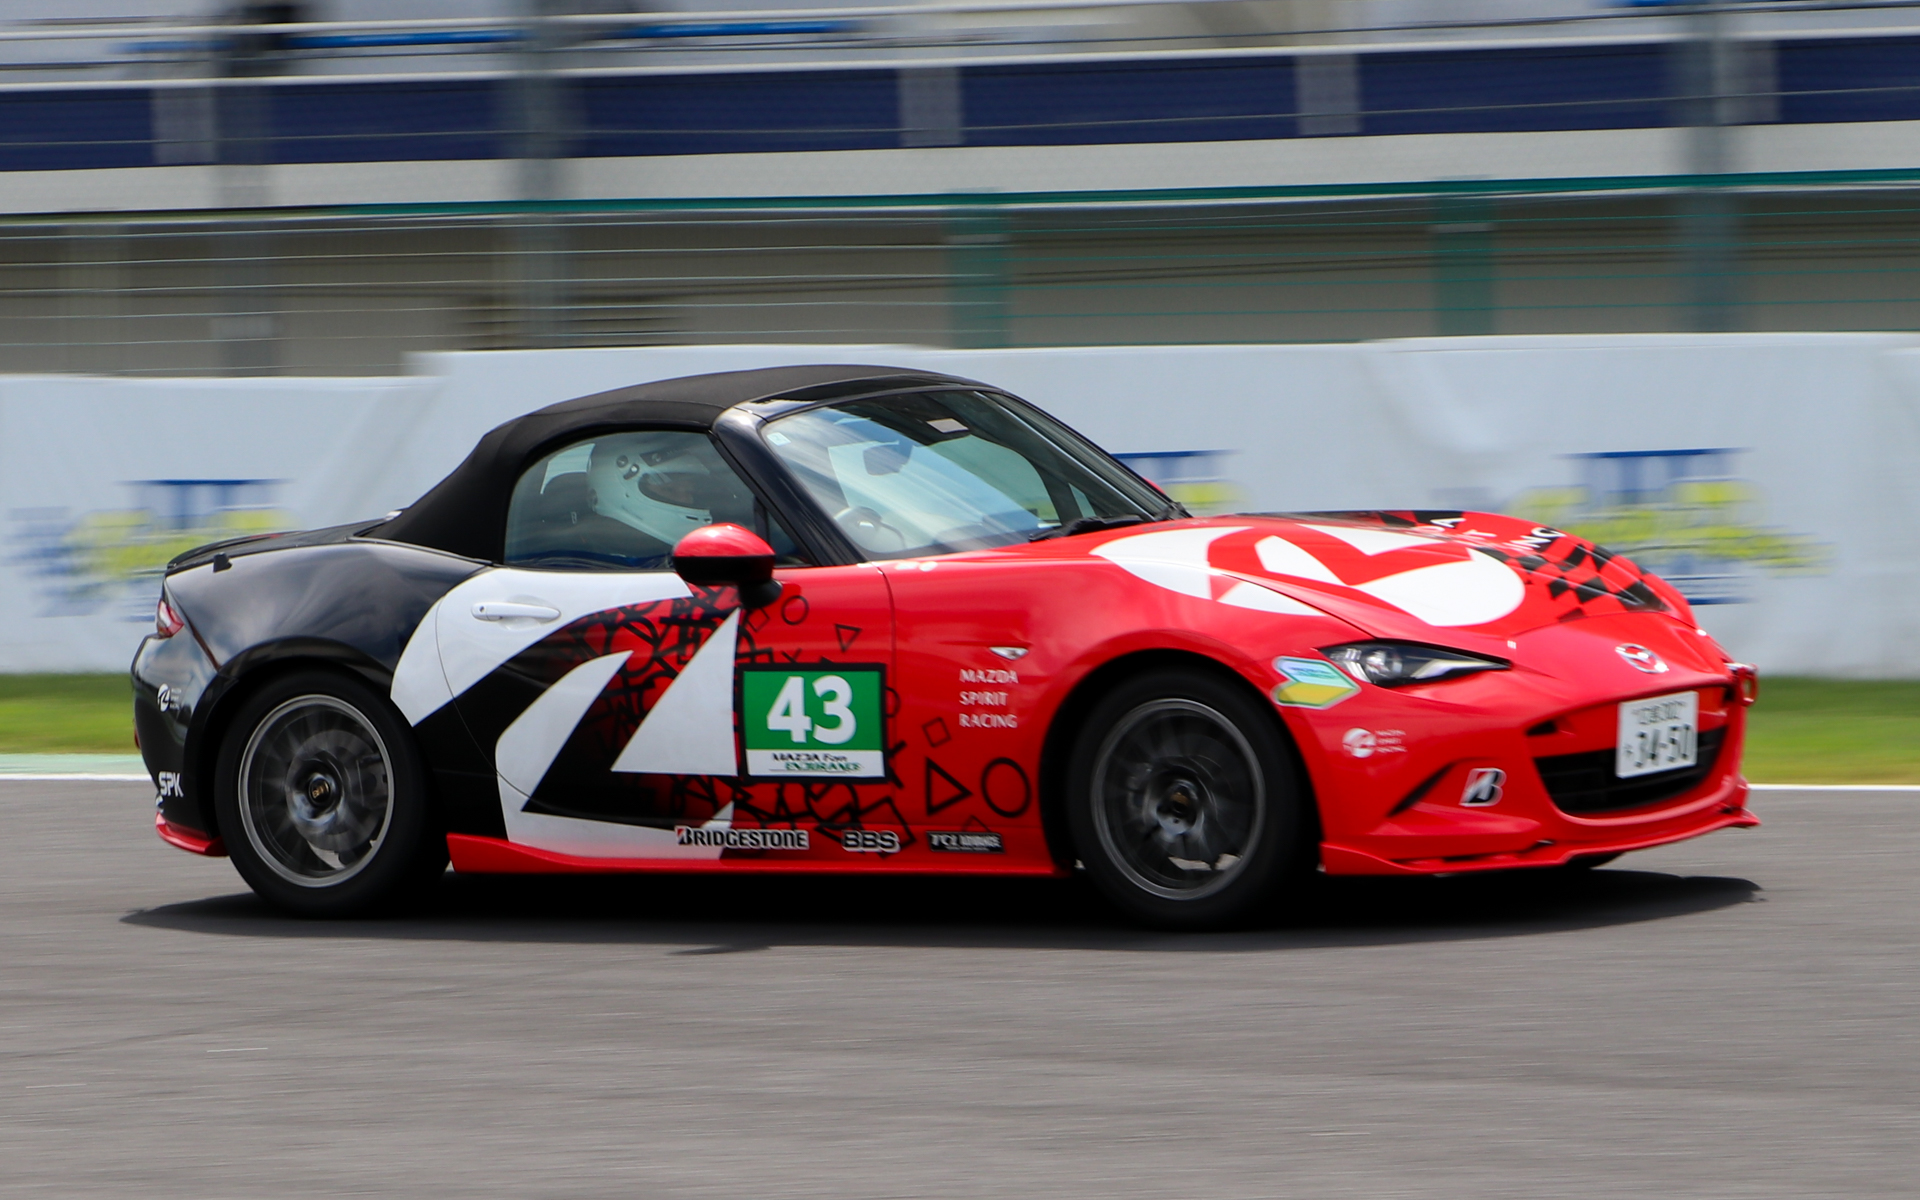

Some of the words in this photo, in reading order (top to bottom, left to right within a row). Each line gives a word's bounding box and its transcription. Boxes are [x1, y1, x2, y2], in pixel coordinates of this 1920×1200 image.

[959, 668, 1019, 684] MAZDA
[959, 690, 1008, 706] SPIRIT
[766, 674, 857, 745] 43
[959, 713, 1018, 728] RACING
[1635, 723, 1696, 768] 34-50
[158, 771, 184, 797] SPK
[676, 827, 809, 848] BRIDGESTONE
[843, 830, 900, 852] BBS
